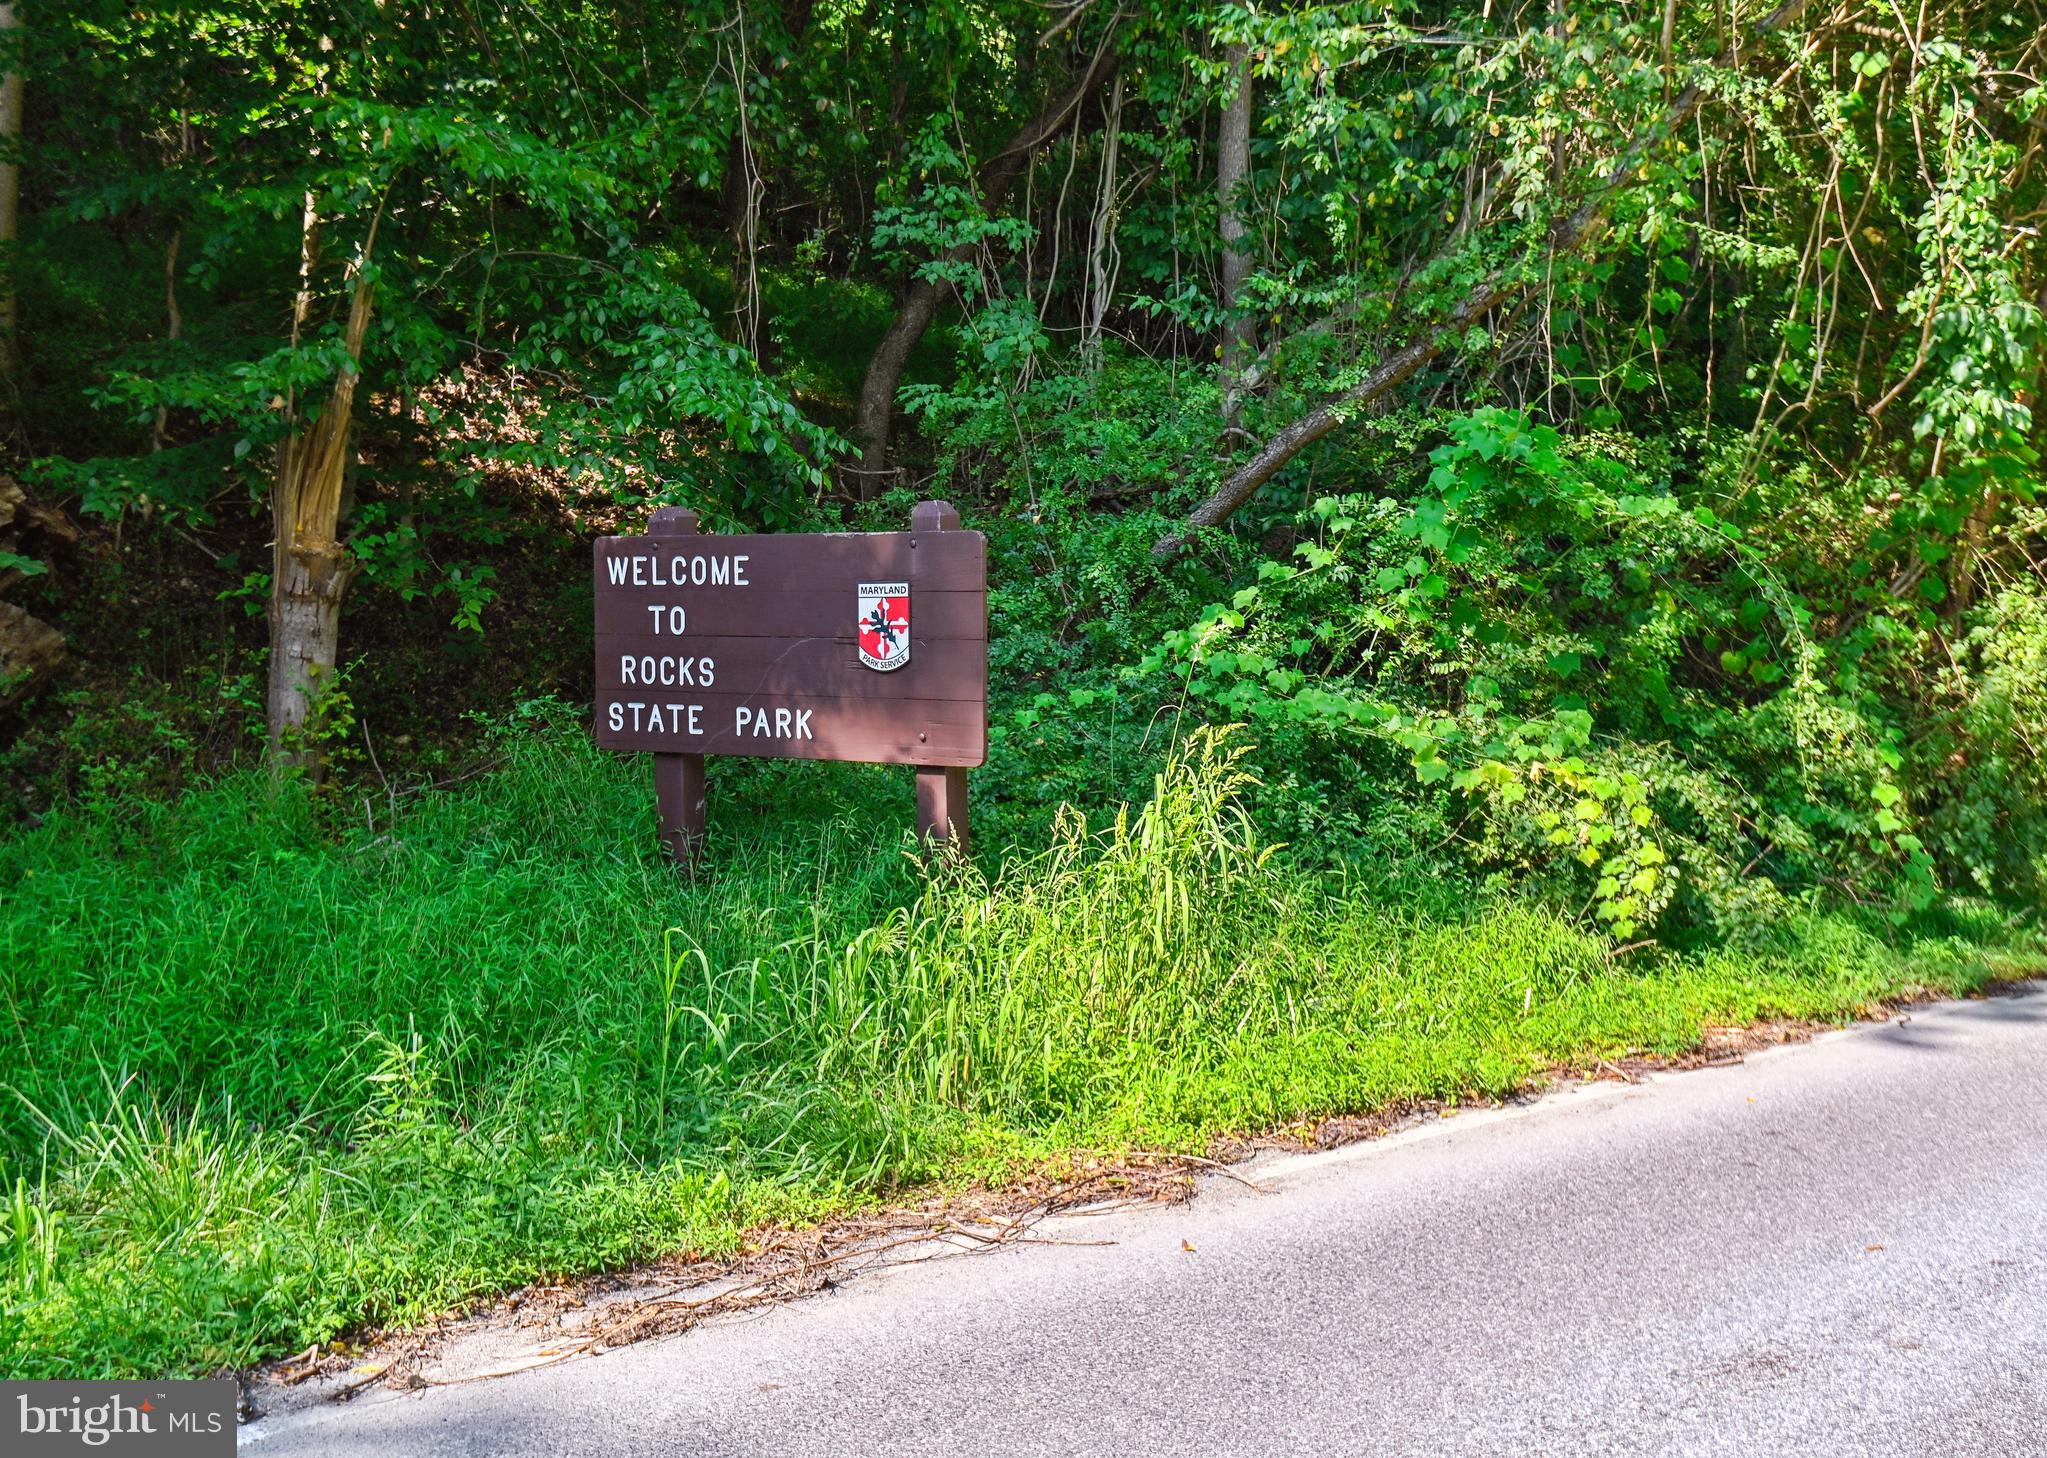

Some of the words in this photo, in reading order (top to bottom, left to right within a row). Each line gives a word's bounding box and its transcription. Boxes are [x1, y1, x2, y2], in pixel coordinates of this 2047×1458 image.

[606, 555, 751, 586] WELCOME
[860, 586, 907, 595] MARYLAND
[647, 605, 687, 636] TO
[620, 655, 715, 688] ROCKS
[862, 654, 879, 669] PARK
[880, 654, 906, 669] SERVICE
[608, 701, 704, 735] STATE
[735, 706, 814, 741] PARK
